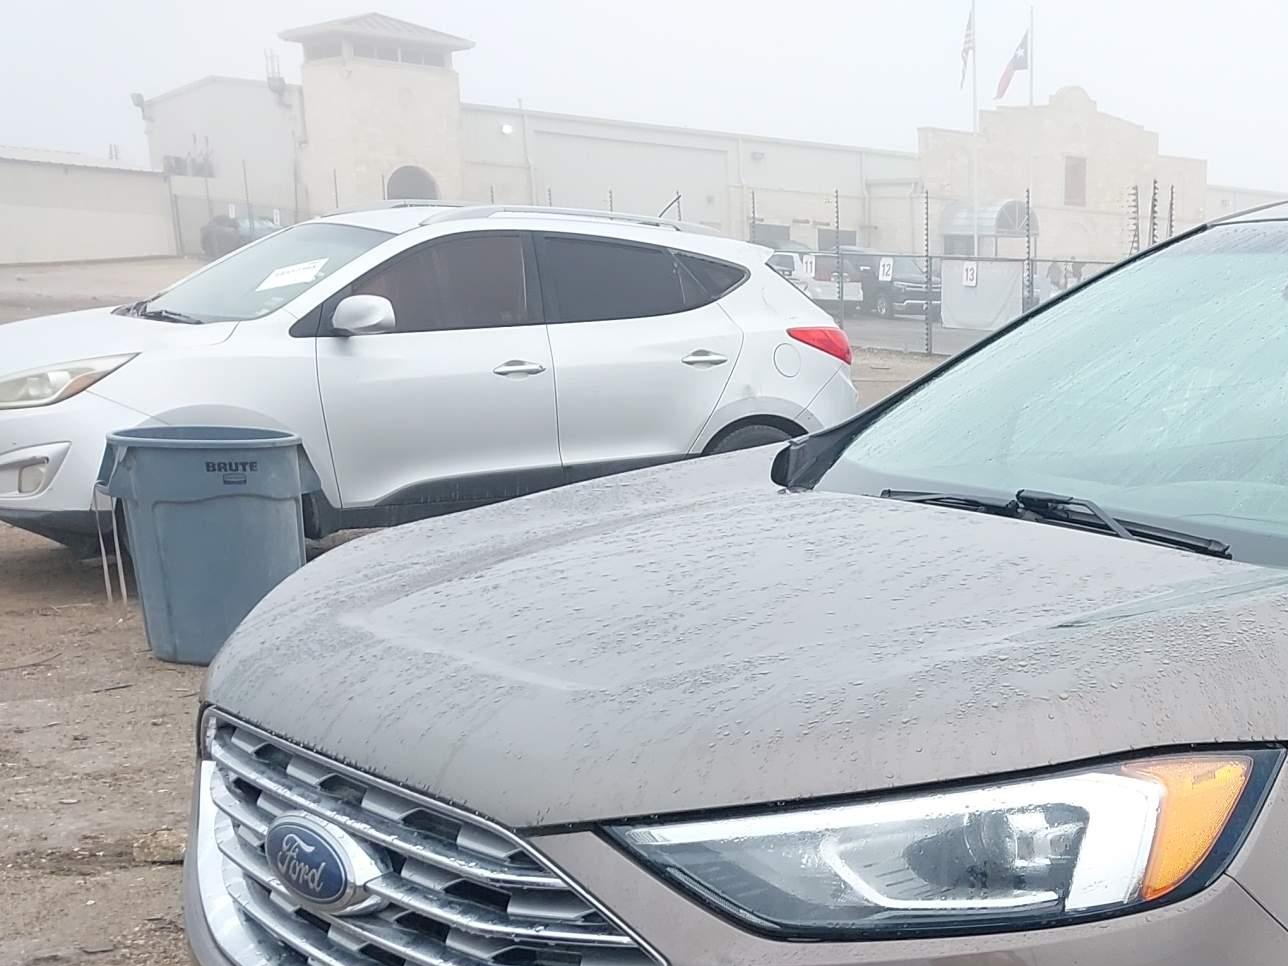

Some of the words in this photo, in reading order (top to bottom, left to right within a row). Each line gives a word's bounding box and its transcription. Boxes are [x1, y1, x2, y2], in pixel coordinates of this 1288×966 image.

[804, 260, 813, 273] 11
[881, 263, 891, 277] 12
[965, 268, 975, 281] 13
[205, 461, 257, 472] BRUTE
[277, 833, 326, 892] Ford
